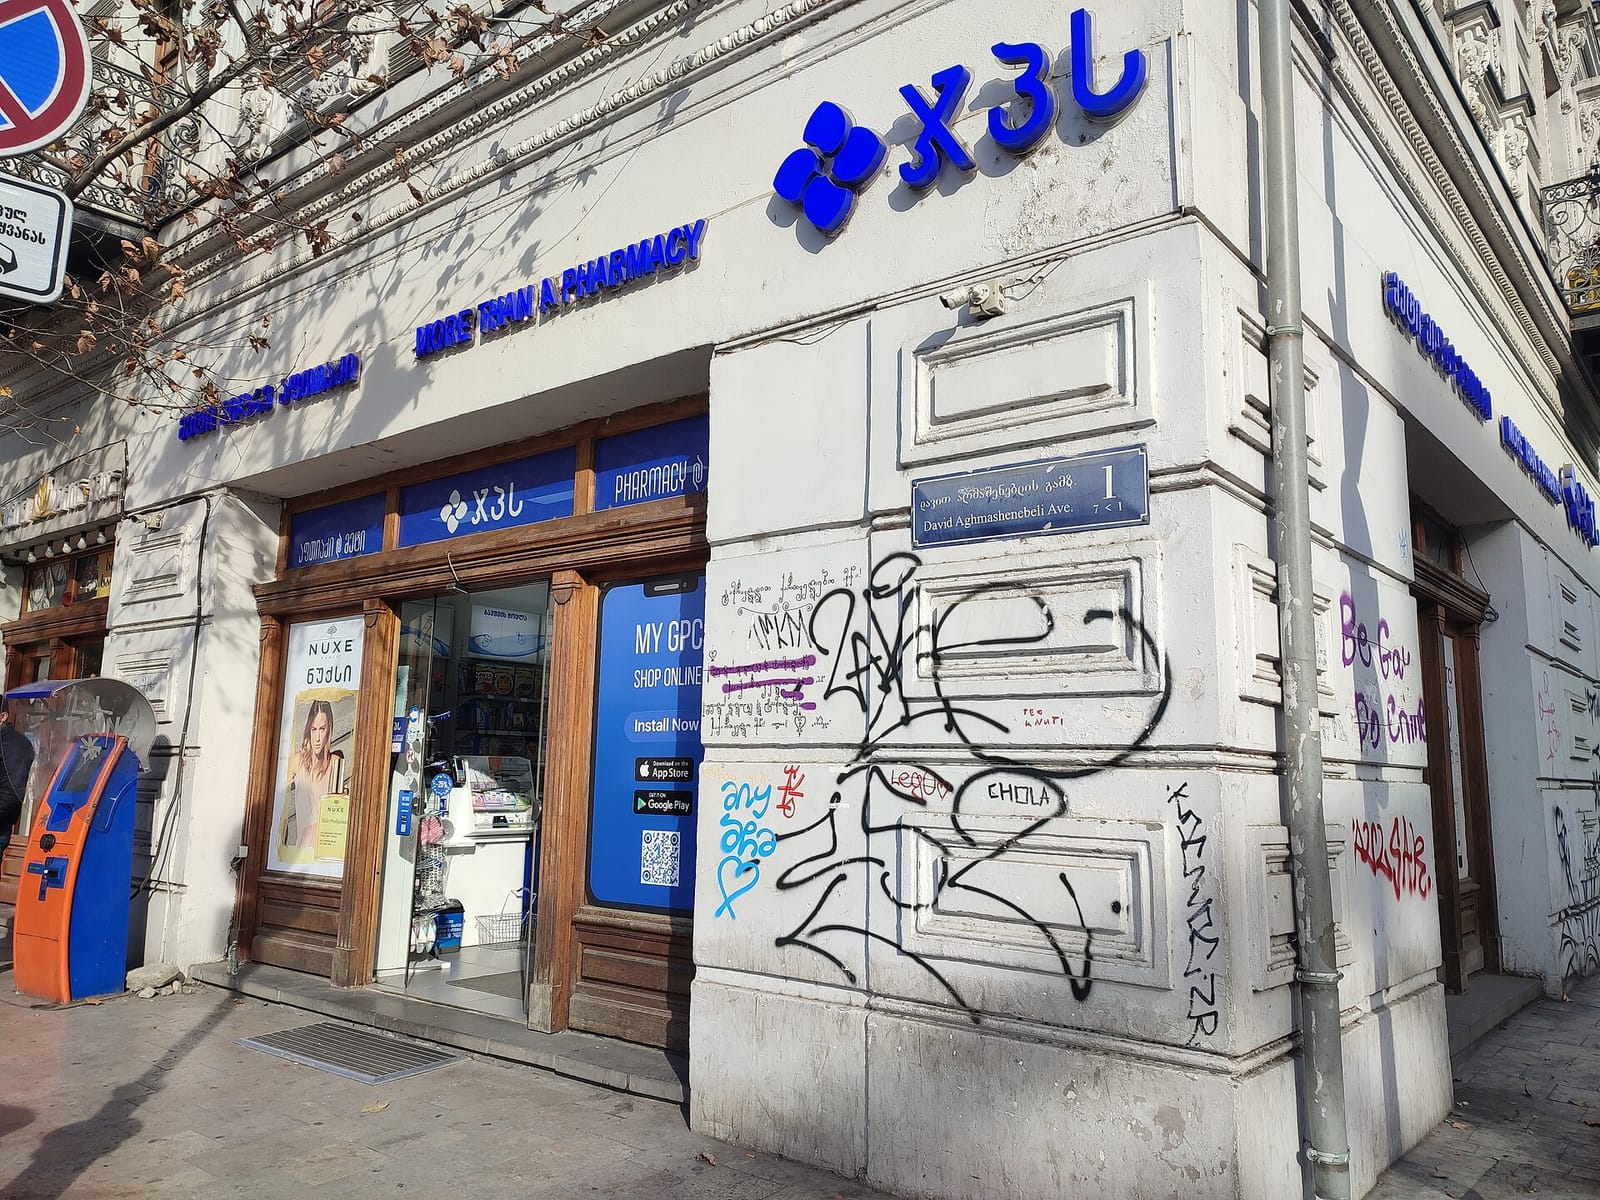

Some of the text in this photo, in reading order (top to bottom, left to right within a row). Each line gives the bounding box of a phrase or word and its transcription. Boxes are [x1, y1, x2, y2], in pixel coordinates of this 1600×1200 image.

[415, 218, 706, 358] MORE THAN A PHARMACY
[614, 460, 688, 504] PHARMACY
[1101, 465, 1117, 500] 1
[920, 495, 951, 512] დავით
[1092, 504, 1099, 515] 7
[923, 503, 1074, 532] David Aghmashenebeli Ave.
[344, 529, 366, 554] მეტი
[635, 618, 703, 655] MY GPC
[1340, 589, 1372, 669] Be
[308, 639, 353, 656] NUXE
[306, 664, 352, 685] ნუქსი
[633, 668, 661, 689] SHOP
[664, 665, 702, 687] ONLINE
[634, 717, 669, 733] Install
[672, 716, 700, 732] Now
[652, 767, 668, 780] App
[668, 767, 689, 778] Store
[648, 799, 690, 813] Google Play
[988, 782, 1050, 807] CHOLA
